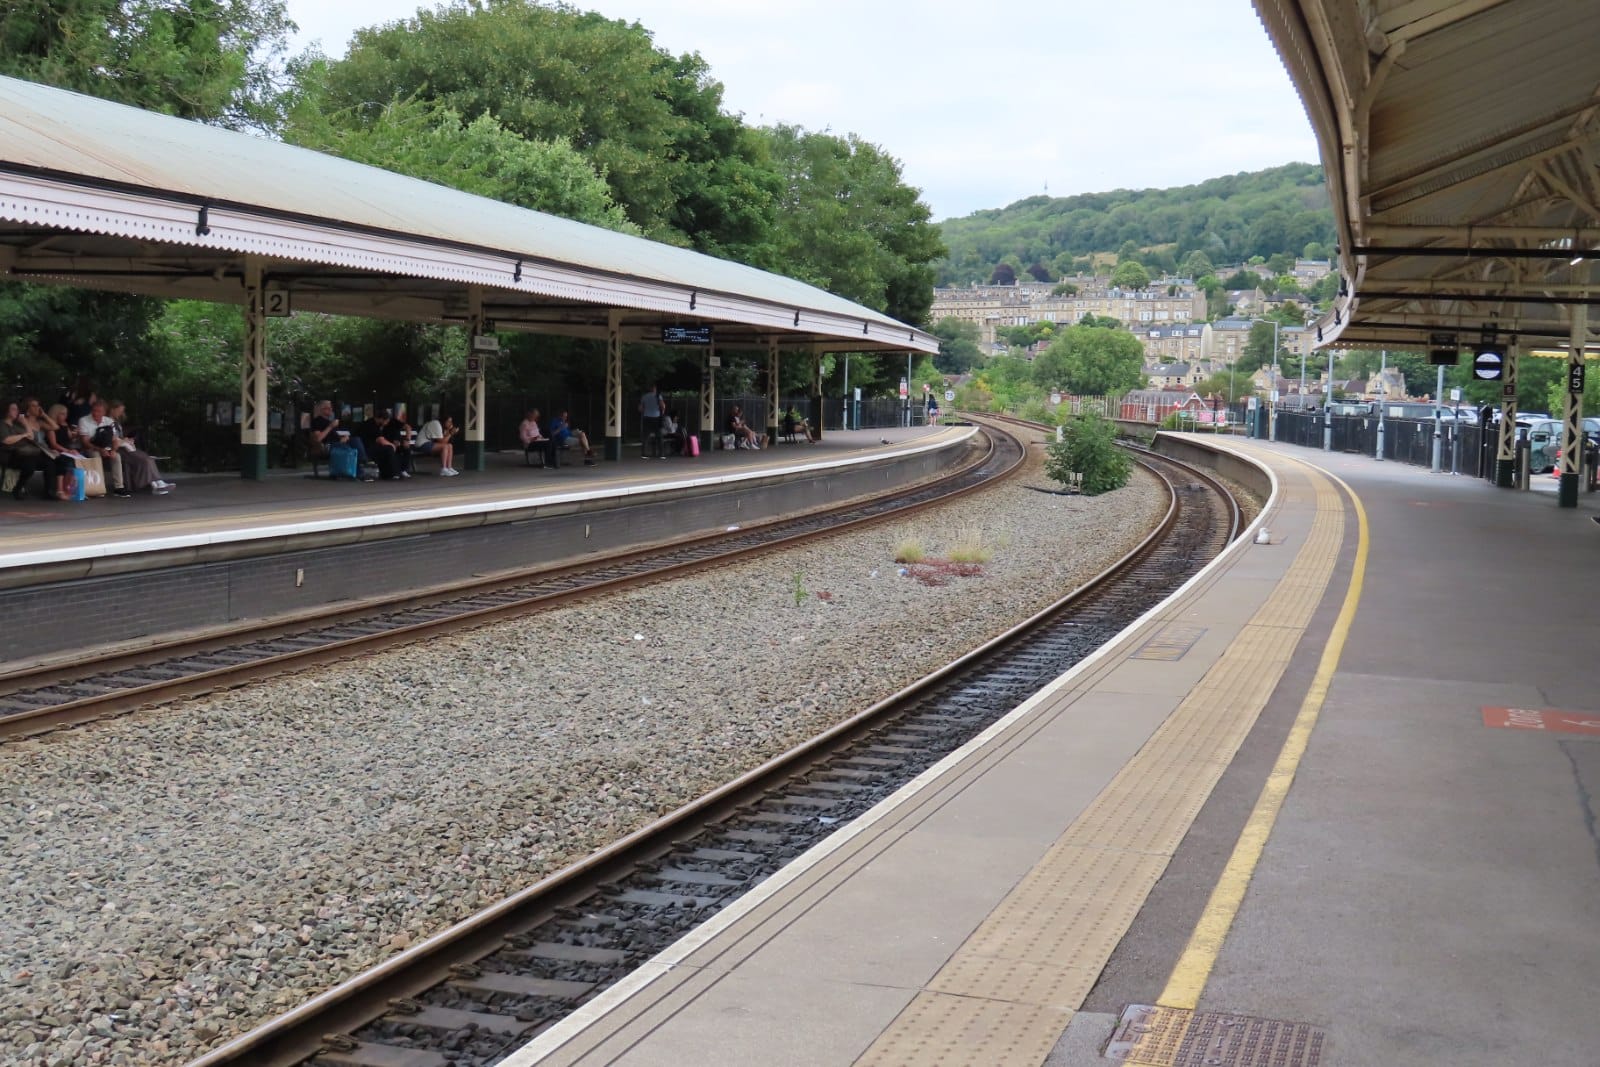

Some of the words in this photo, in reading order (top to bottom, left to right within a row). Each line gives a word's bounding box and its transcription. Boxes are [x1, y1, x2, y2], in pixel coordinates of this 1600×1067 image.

[270, 294, 282, 312] 2
[1572, 366, 1581, 376] 4
[1572, 378, 1581, 388] 5
